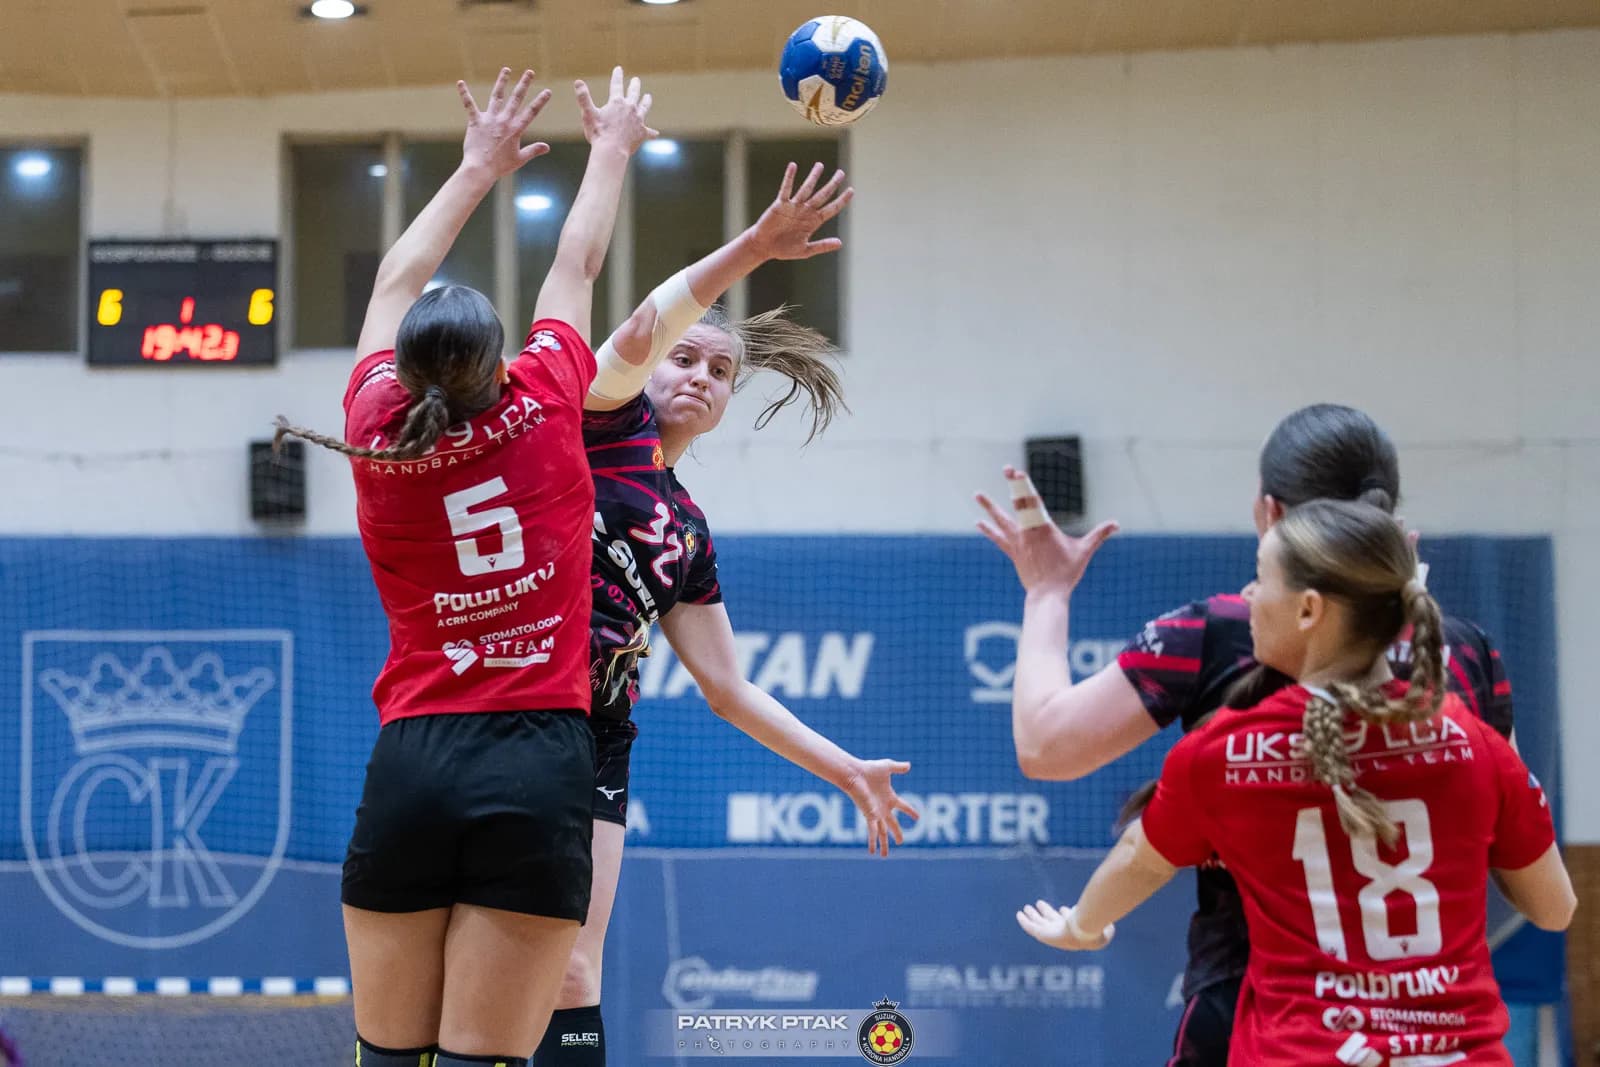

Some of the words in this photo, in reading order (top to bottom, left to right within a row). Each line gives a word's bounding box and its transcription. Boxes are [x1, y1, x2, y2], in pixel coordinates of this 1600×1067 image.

[841, 45, 872, 110] molten
[97, 288, 124, 326] 6
[248, 288, 275, 326] 6
[369, 449, 484, 476] HANDBALL
[494, 414, 547, 446] TEAM
[443, 475, 526, 577] 5
[437, 618, 445, 628] A
[446, 615, 469, 627] CRH
[469, 601, 520, 622] COMPANY
[479, 614, 564, 645] STOMATOLOGIA
[485, 636, 555, 655] STEAM
[1225, 763, 1387, 785] HANDLL
[1403, 747, 1474, 766] TEAM
[1292, 798, 1443, 963] 18
[1370, 1007, 1466, 1026] STOMATOLOGIA
